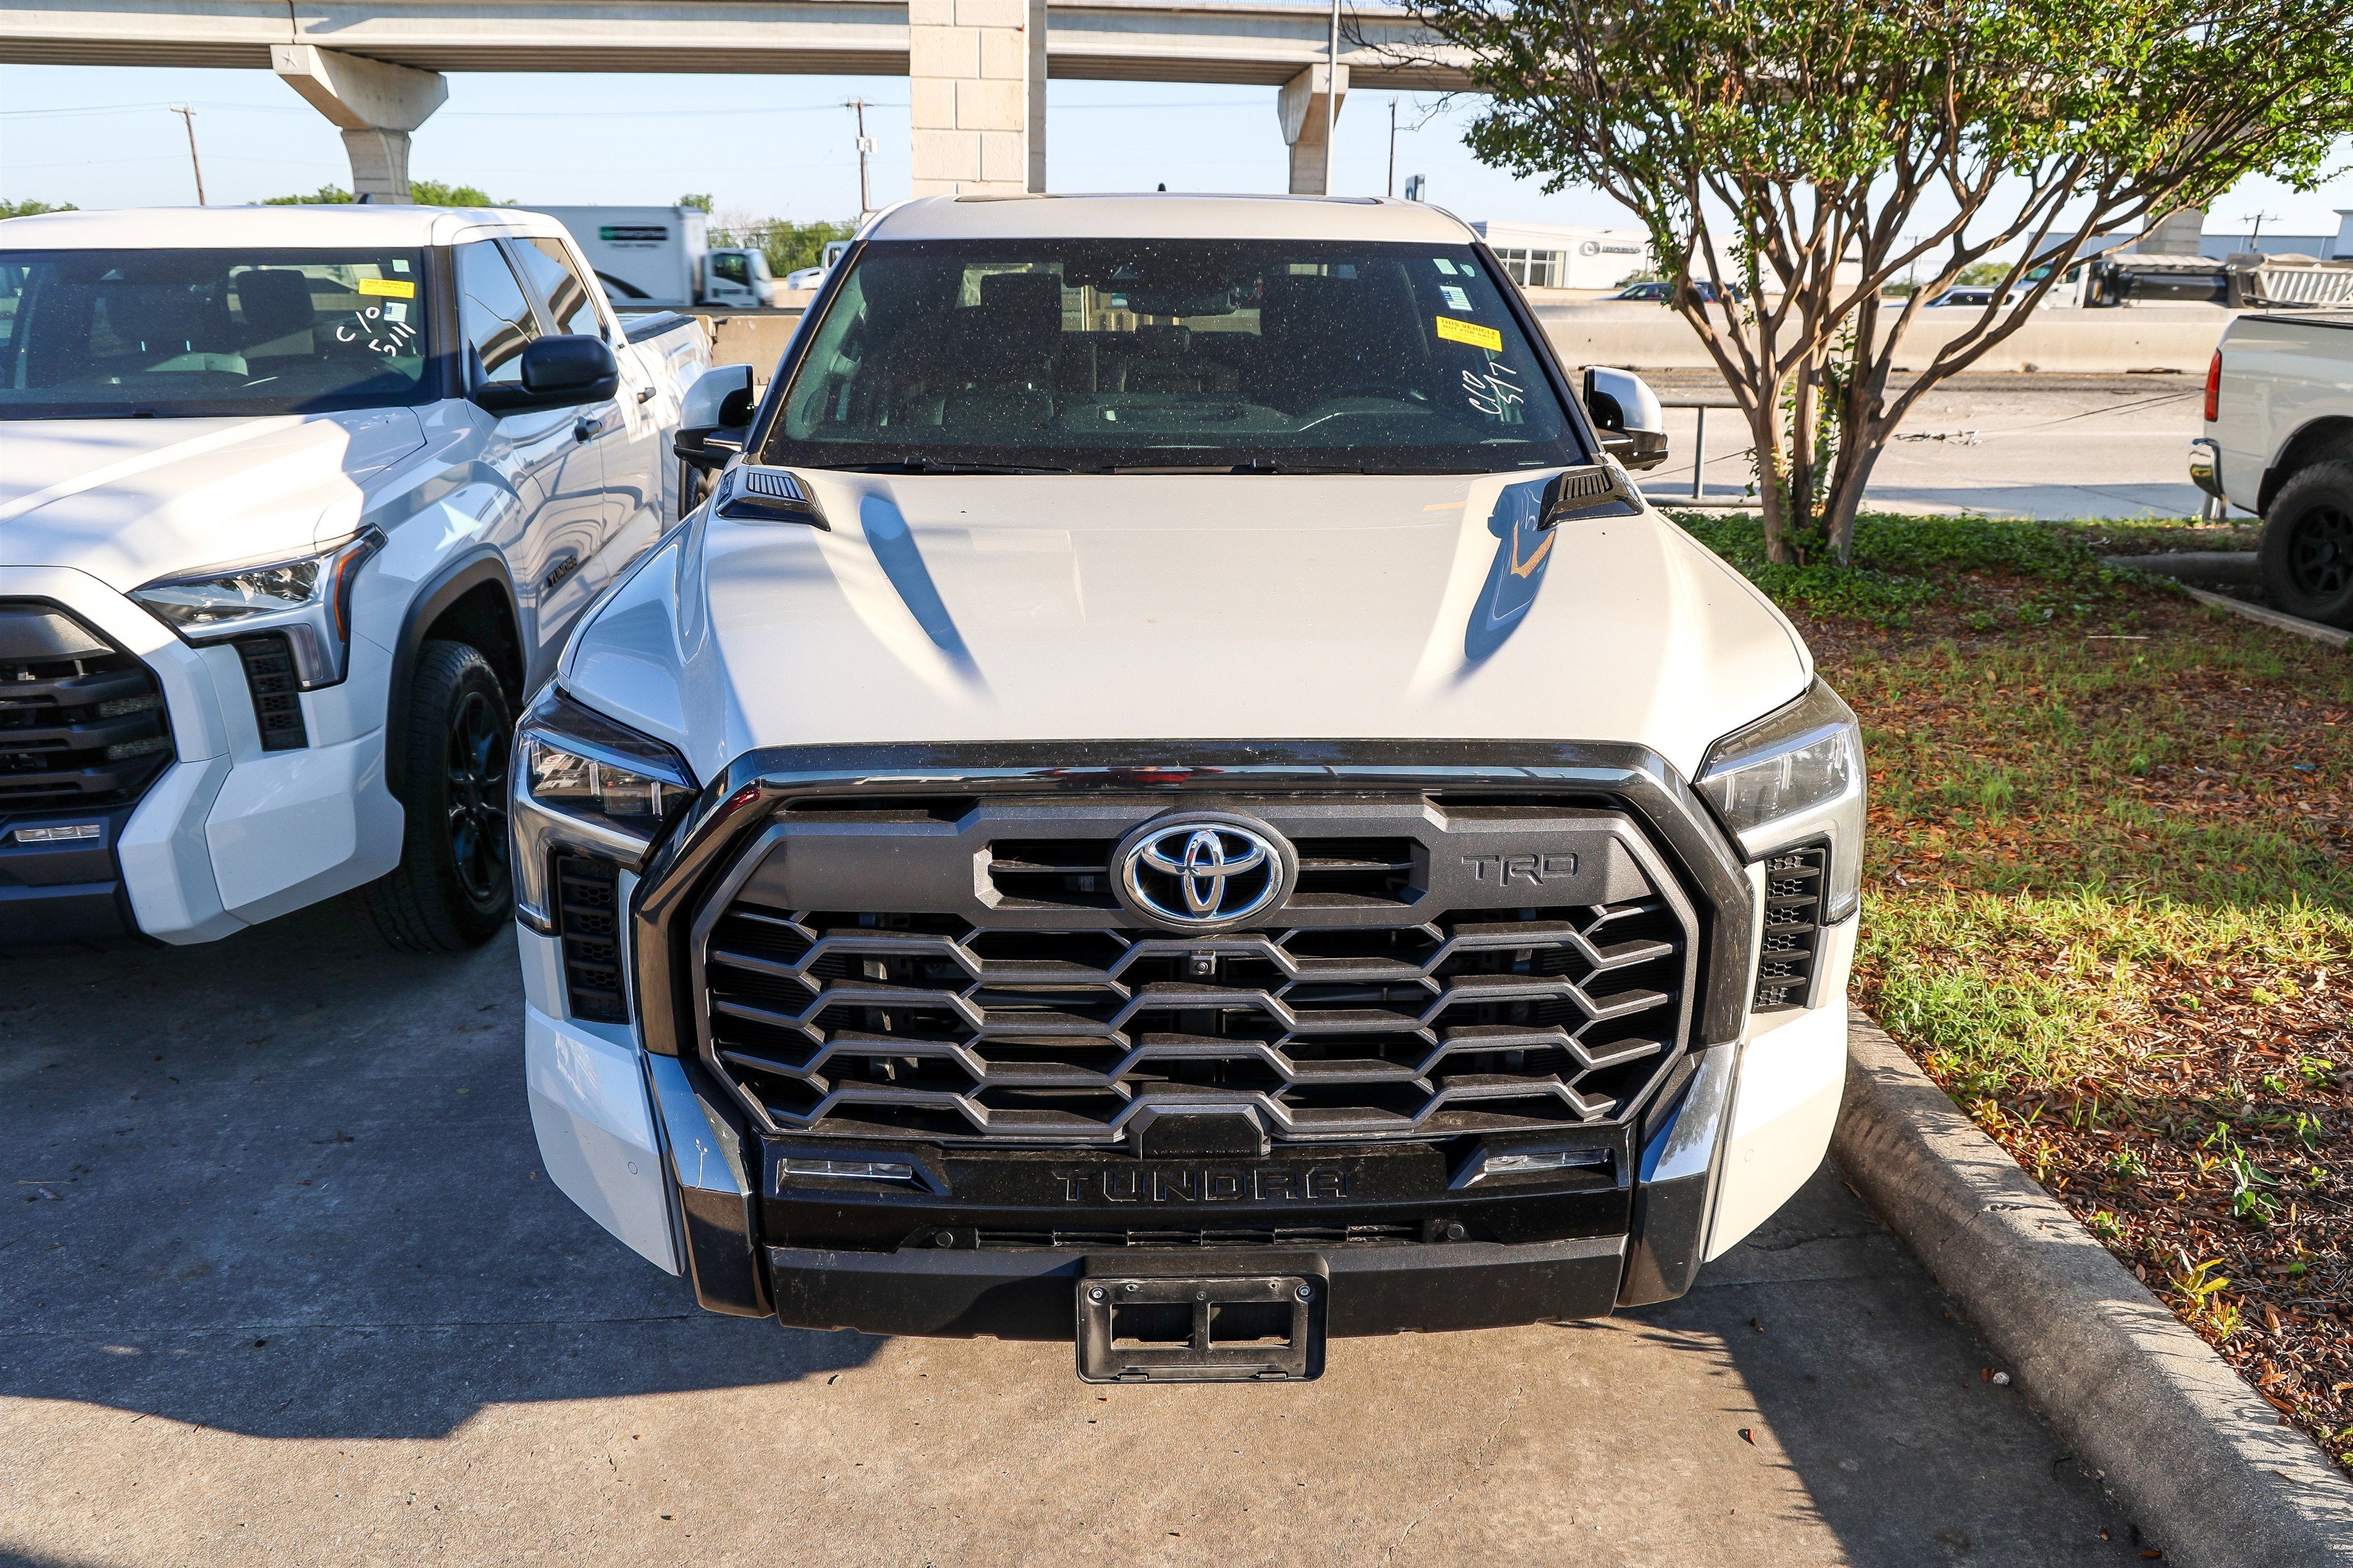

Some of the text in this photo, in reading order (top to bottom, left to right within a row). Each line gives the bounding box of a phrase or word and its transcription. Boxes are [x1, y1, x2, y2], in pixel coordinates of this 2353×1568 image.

[1462, 323, 1496, 336] VEHICLE
[1461, 852, 1579, 887] TRD
[1051, 1167, 1349, 1202] TUNDRA
